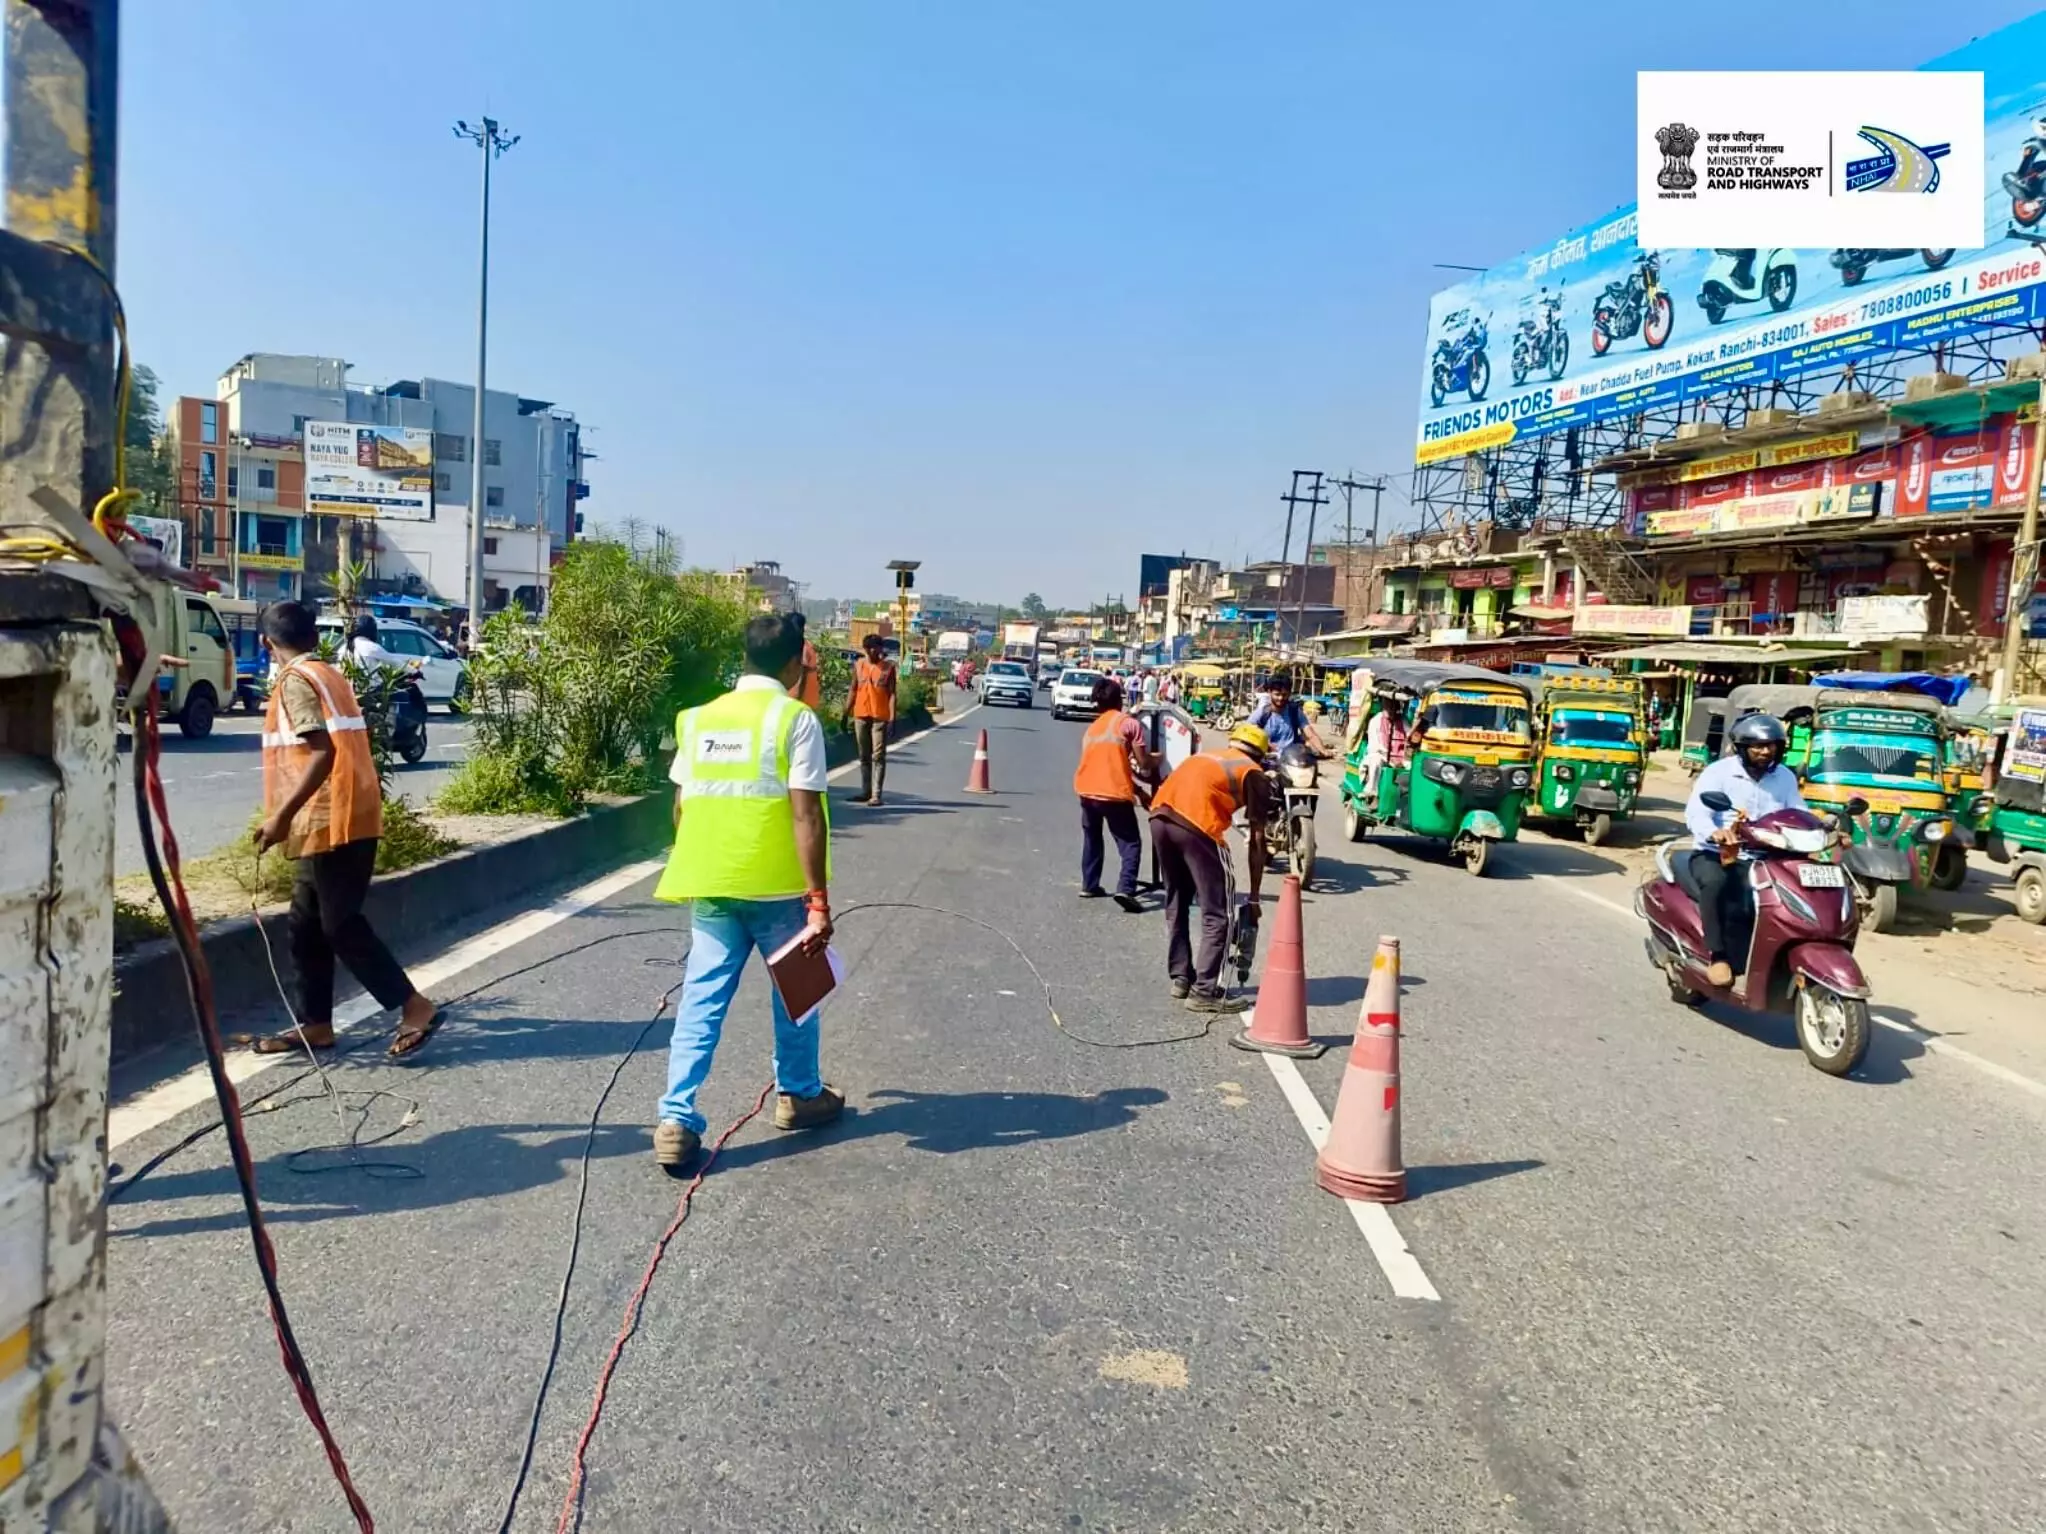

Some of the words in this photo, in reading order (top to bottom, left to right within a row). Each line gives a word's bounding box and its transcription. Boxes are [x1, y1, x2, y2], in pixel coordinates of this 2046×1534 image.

[1813, 312, 1849, 334] Sales
[1860, 281, 1952, 321] 7808800056
[1977, 258, 2041, 291] Service
[1907, 311, 1944, 330] MADHU
[1945, 293, 2019, 322] ENTERPRISES
[1809, 340, 1833, 354] AUTO
[1424, 409, 1481, 442] FRIENDS
[1485, 387, 1553, 425] MOTORS
